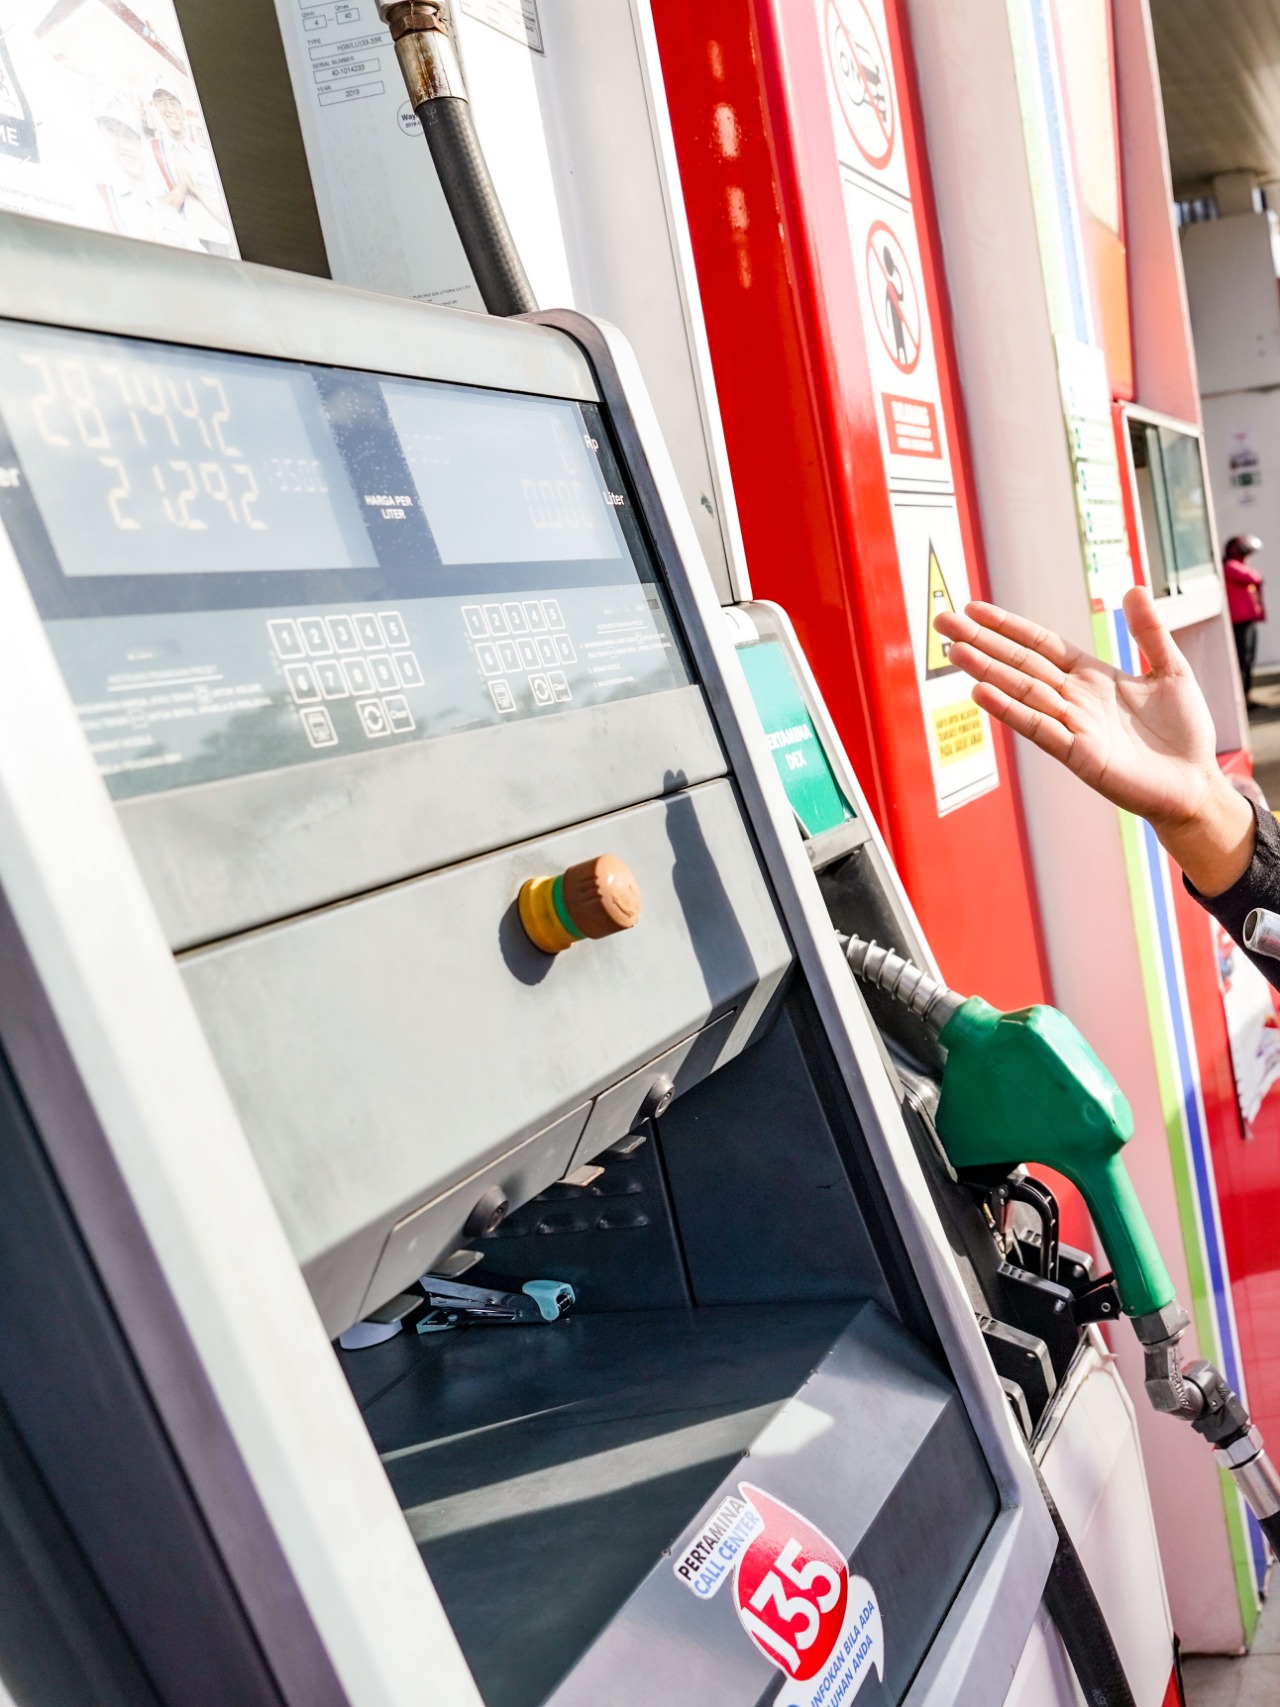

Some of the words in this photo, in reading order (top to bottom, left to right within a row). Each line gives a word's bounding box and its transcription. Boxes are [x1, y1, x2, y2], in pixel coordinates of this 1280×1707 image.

[345, 89, 360, 98] 2019
[584, 434, 599, 453] Rp
[364, 494, 396, 506] HARGA
[394, 495, 413, 507] PER
[603, 491, 625, 506] Liter
[381, 508, 407, 520] LITER
[471, 615, 480, 628] 1
[492, 613, 501, 626] 2
[511, 611, 520, 624] 3
[532, 610, 539, 622] 4
[549, 608, 557, 620] 5
[282, 630, 292, 647] 1
[309, 628, 322, 644] 2
[337, 626, 348, 641] 3
[365, 624, 374, 638] 4
[389, 621, 399, 637] 5
[485, 651, 493, 665] 6
[505, 649, 512, 662] 7
[525, 647, 533, 660] 8
[543, 645, 551, 657] 9
[562, 643, 569, 655] 0
[297, 674, 308, 691] 6
[324, 671, 334, 687] 7
[352, 668, 363, 684] 8
[378, 665, 389, 680] 9
[403, 662, 413, 677] 0
[765, 723, 813, 750] ERTAMINA
[785, 750, 808, 770] DEX
[677, 1498, 745, 1581] PERTAMINA
[694, 1560, 726, 1595] CALL
[718, 1510, 760, 1561] CENTER
[741, 1537, 841, 1674] 135
[843, 1624, 861, 1656] BILA
[859, 1600, 875, 1629] ADA
[827, 1667, 854, 1707] UHAN
[852, 1634, 874, 1674] ANDA
